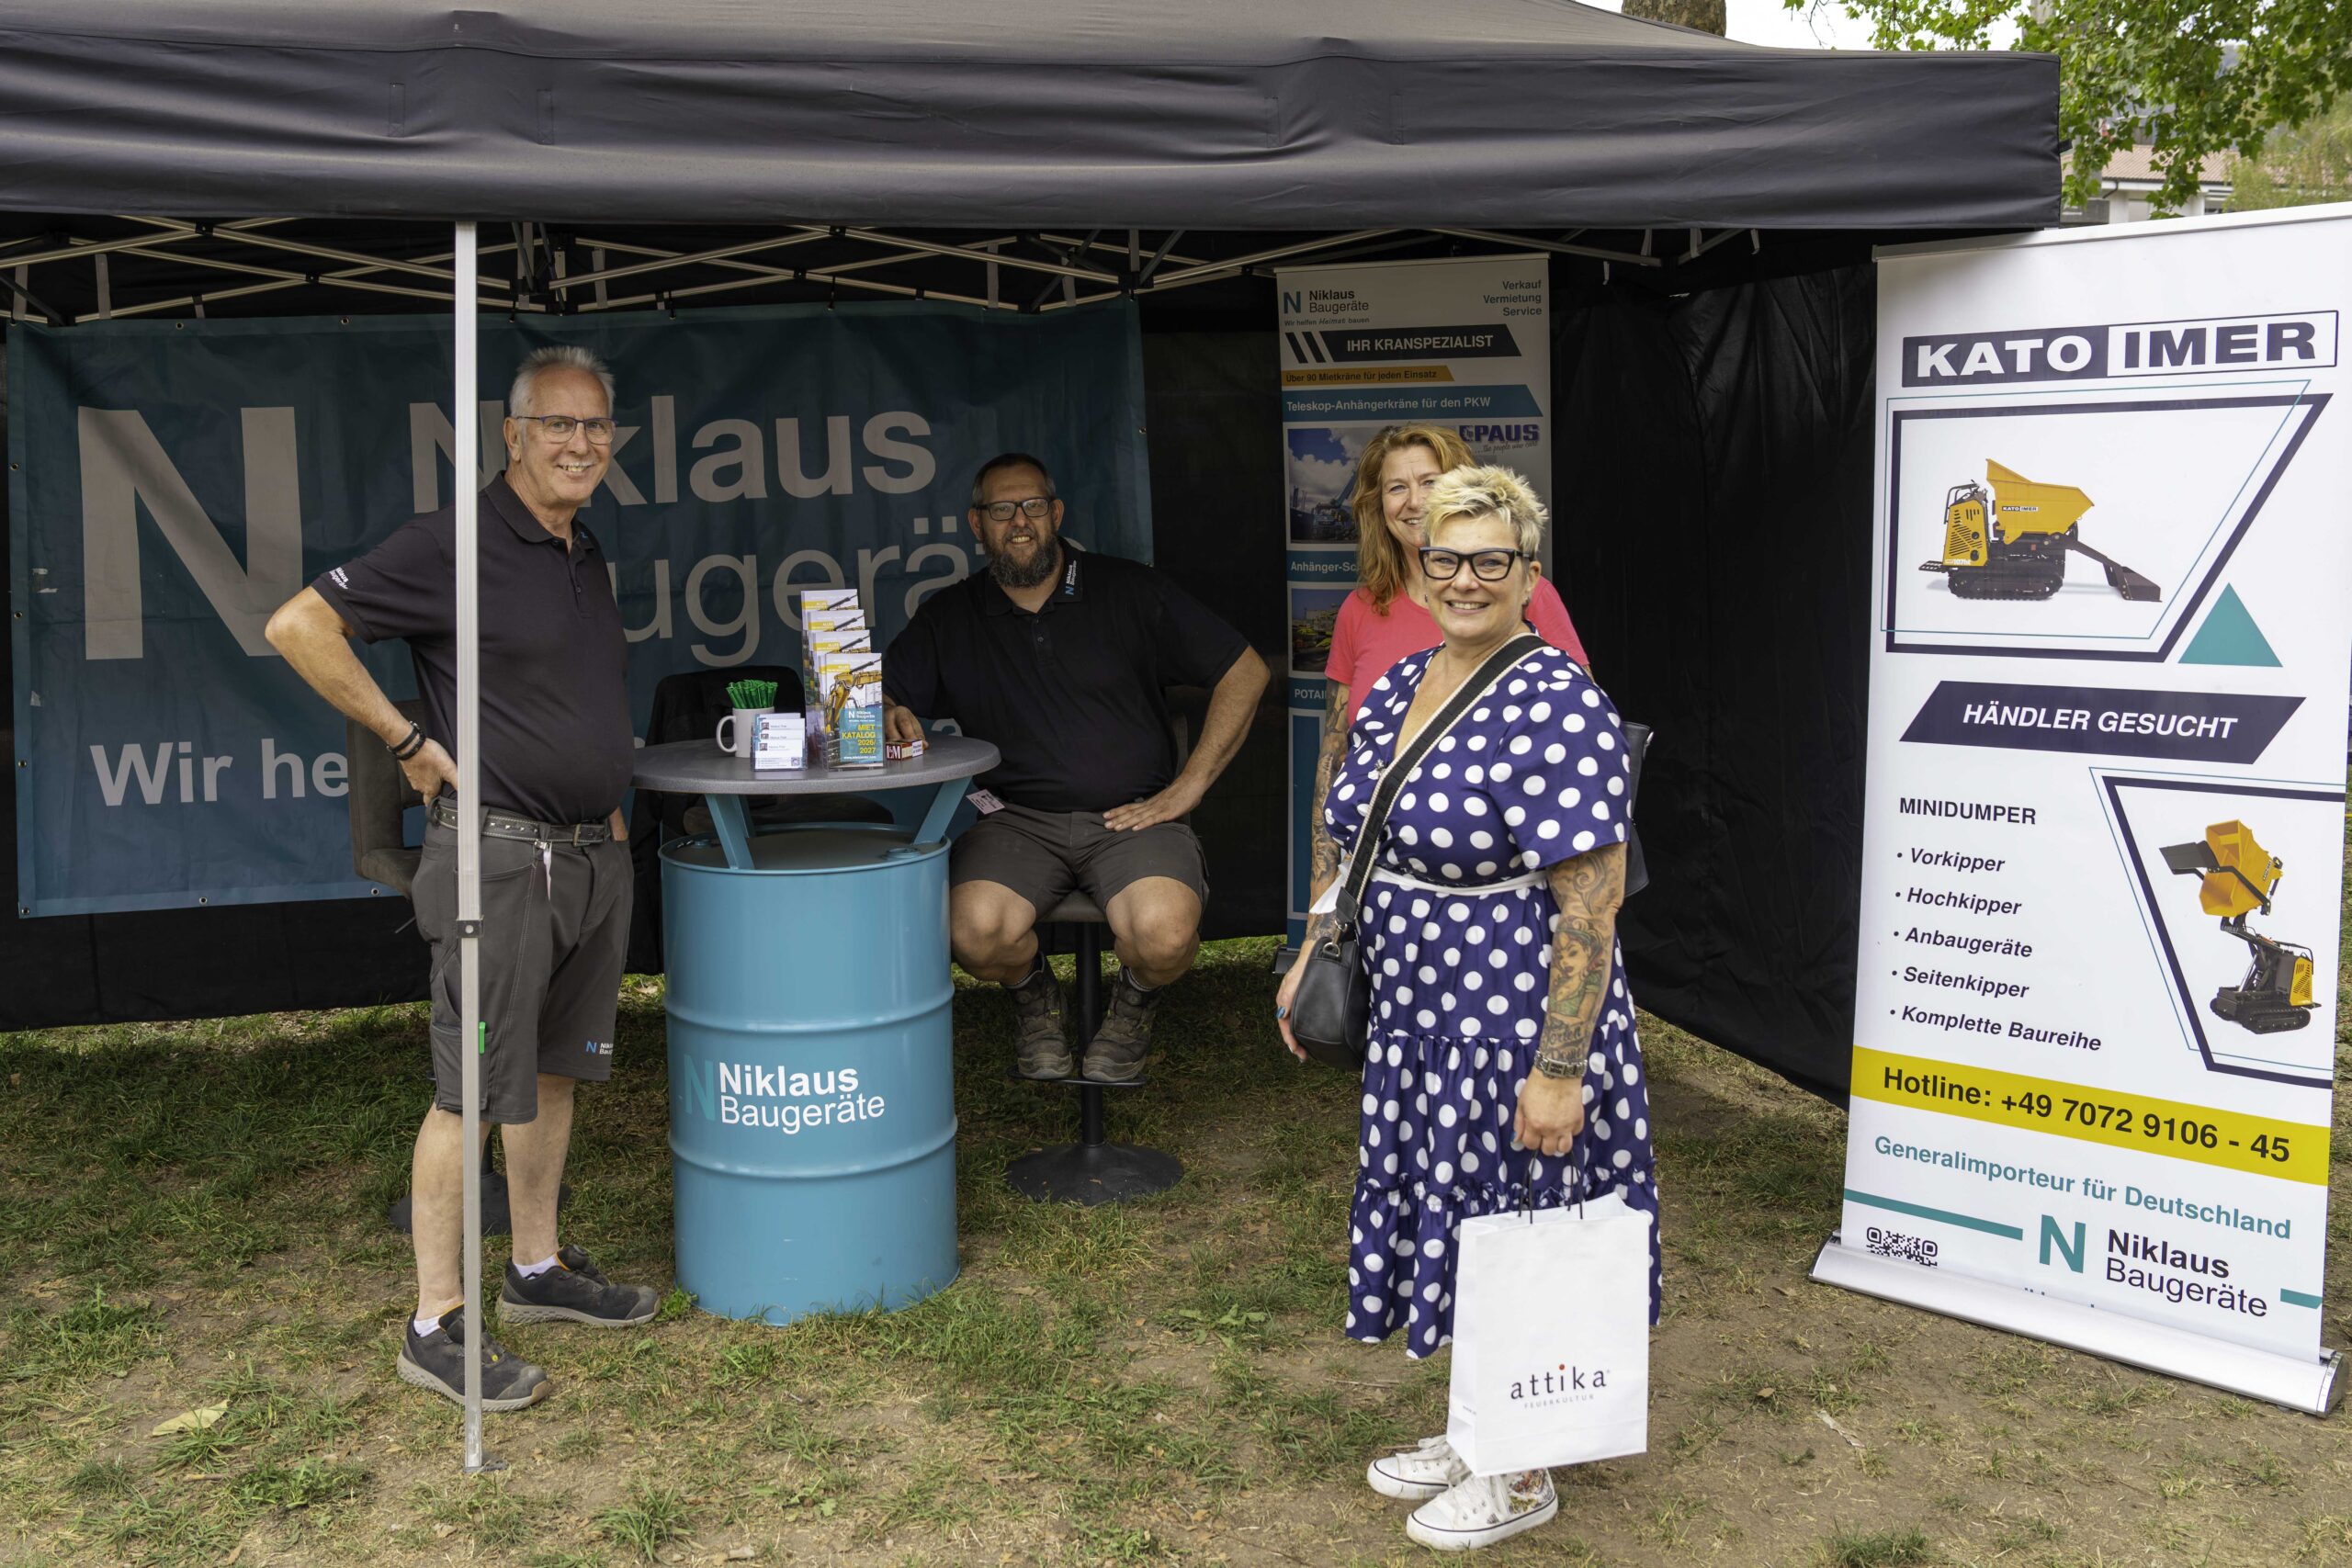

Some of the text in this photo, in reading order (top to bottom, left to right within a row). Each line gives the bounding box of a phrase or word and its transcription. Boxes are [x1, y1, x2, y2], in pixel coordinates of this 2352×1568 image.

[1309, 290, 1355, 300] Niklaus
[1483, 294, 1542, 304] Vermietung
[1502, 280, 1542, 289] Verkauf
[1283, 291, 1301, 313] N
[1309, 301, 1369, 314] Baugeräte
[1502, 307, 1542, 316] Service
[1347, 335, 1494, 352] IHR KRANSPEZIALIST
[1917, 321, 2316, 378] KATO IMER
[1306, 373, 1317, 381] 90
[1319, 372, 1362, 381] Mietkräne
[1363, 370, 1375, 379] für
[1378, 371, 1402, 381] jeden
[1404, 370, 1437, 378] Einsatz
[1287, 397, 1490, 412] Teleskop-Anhängerkräne für den PKW
[409, 395, 935, 513] Nklaus
[78, 406, 303, 660] N
[842, 731, 876, 739] KATALOG
[1962, 700, 2238, 739] HÄNDLER GESUCHT
[90, 741, 233, 807] Wir
[1899, 797, 2037, 825] MINIDUMPER
[1911, 848, 2006, 873] Vorkipper
[1907, 887, 2022, 916] Hochkipper
[1905, 927, 2033, 958] Anbaugeräte
[1904, 966, 2030, 998] Seitenkipper
[1902, 1005, 2101, 1051] Komplette Baureihe
[585, 1041, 598, 1055] N
[718, 1062, 860, 1097] Niklaus
[720, 1093, 886, 1135] Baugeräte
[1883, 1066, 1991, 1107] Hotline:
[2001, 1091, 2052, 1118] +49
[2062, 1099, 2132, 1133] 7072
[2143, 1112, 2218, 1149] 9106
[2250, 1133, 2290, 1163] 45
[1874, 1135, 2291, 1240] Generalimporteur für Deutschland
[2039, 1213, 2086, 1274] N
[2108, 1228, 2230, 1279] Niklaus
[2106, 1257, 2267, 1317] Baugeräte
[1510, 1363, 1607, 1400] attika
